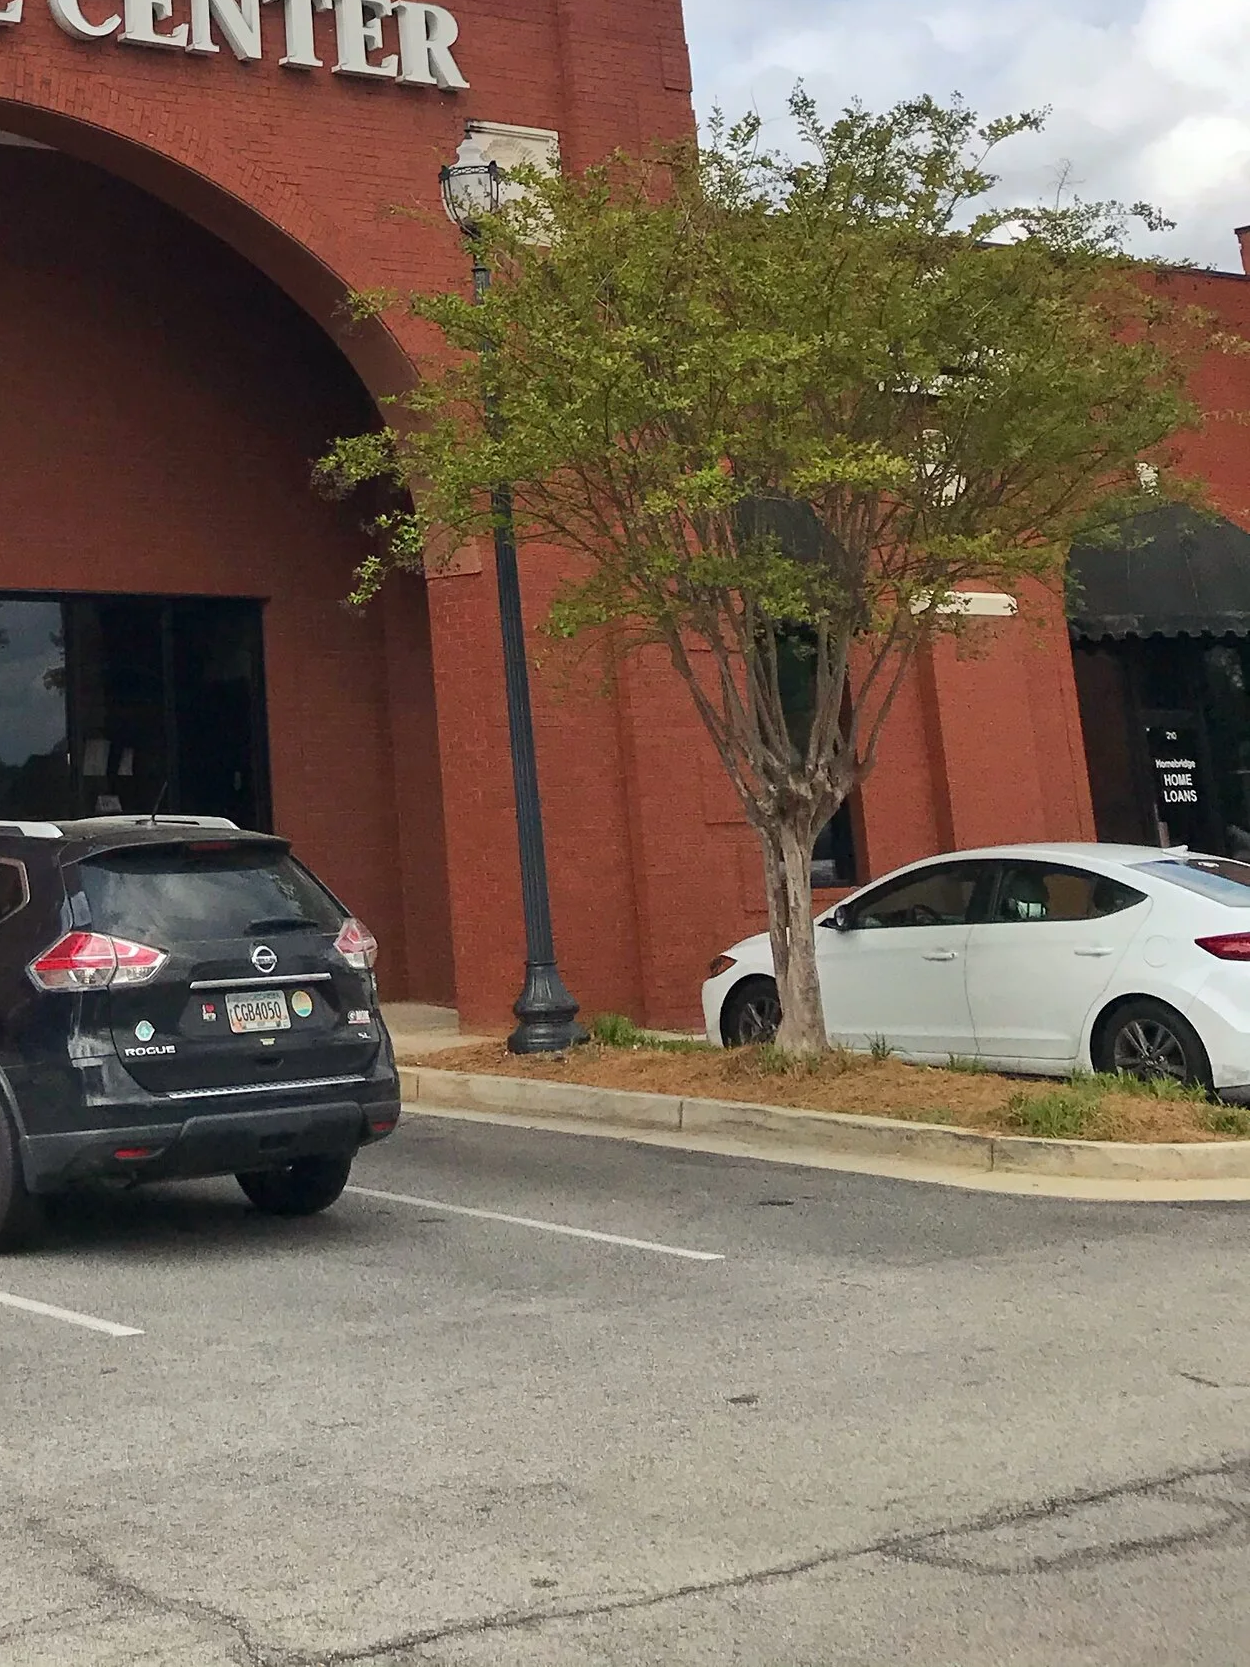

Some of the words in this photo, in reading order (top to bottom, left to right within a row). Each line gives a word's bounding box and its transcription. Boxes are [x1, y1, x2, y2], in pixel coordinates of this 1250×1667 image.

[1163, 774, 1193, 786] HOME
[1163, 790, 1198, 802] LOANS
[233, 1001, 282, 1022] CGB4050
[124, 1045, 176, 1057] ROGUE
